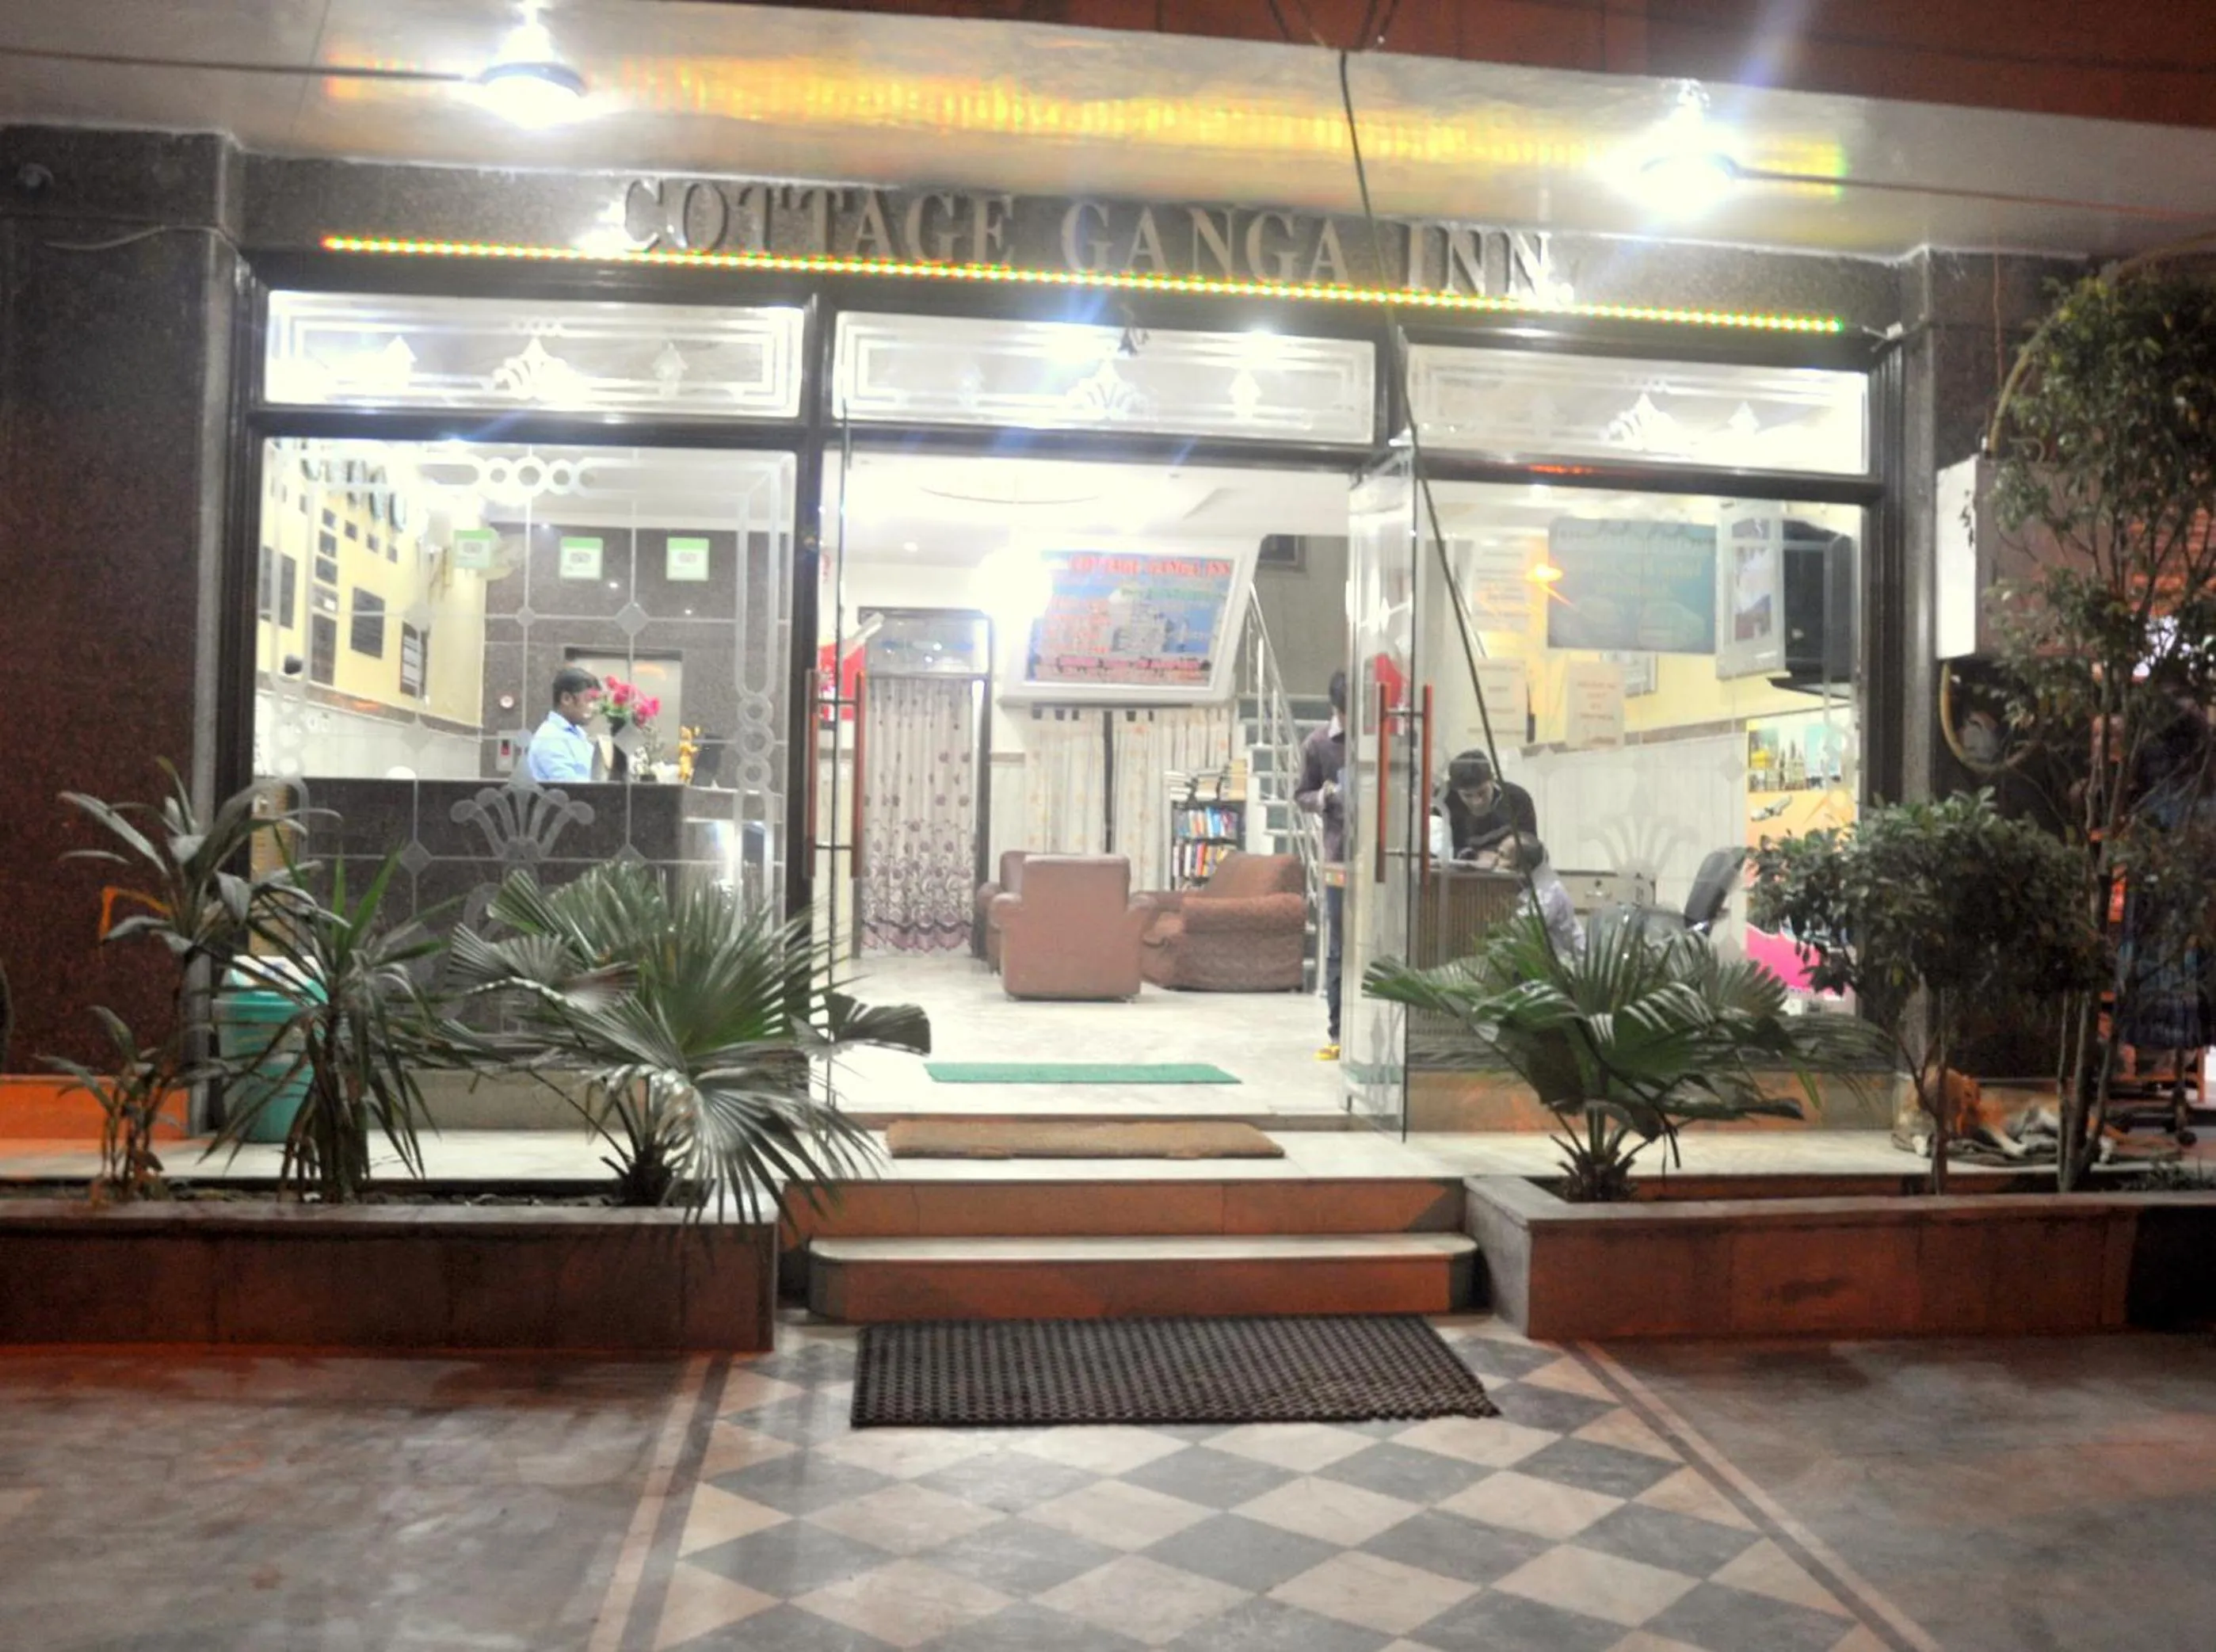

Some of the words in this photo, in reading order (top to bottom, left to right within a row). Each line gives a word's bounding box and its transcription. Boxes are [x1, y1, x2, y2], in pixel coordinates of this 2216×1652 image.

[624, 178, 1014, 265] COTTAGE
[1060, 201, 1349, 284] GANGA
[1401, 219, 1552, 296] INN
